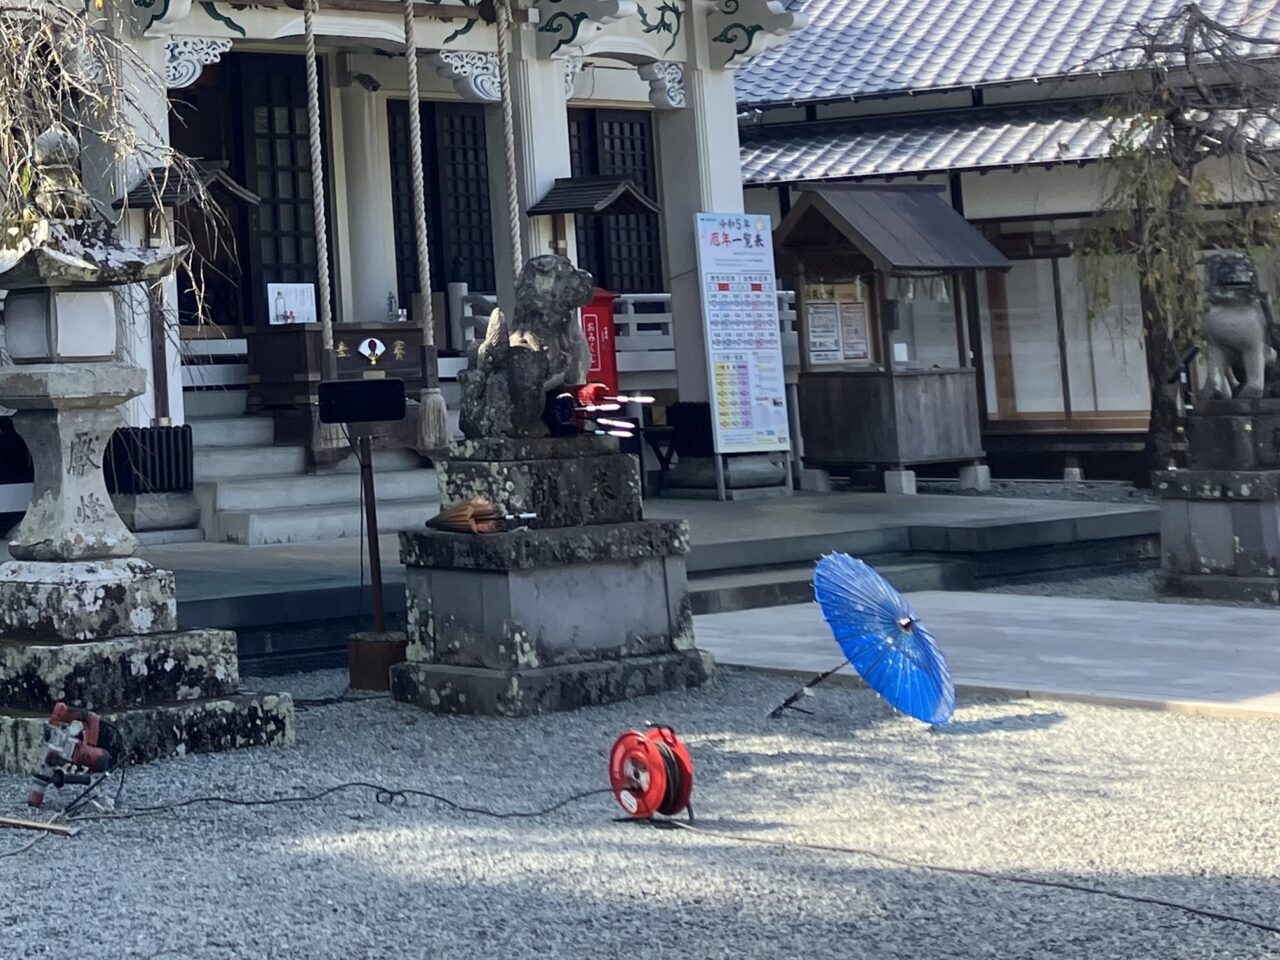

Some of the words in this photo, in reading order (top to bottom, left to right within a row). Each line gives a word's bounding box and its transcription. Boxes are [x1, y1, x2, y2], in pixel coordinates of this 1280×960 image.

[719, 218, 751, 230] 令和5年
[710, 231, 765, 248] 厄年一覧表
